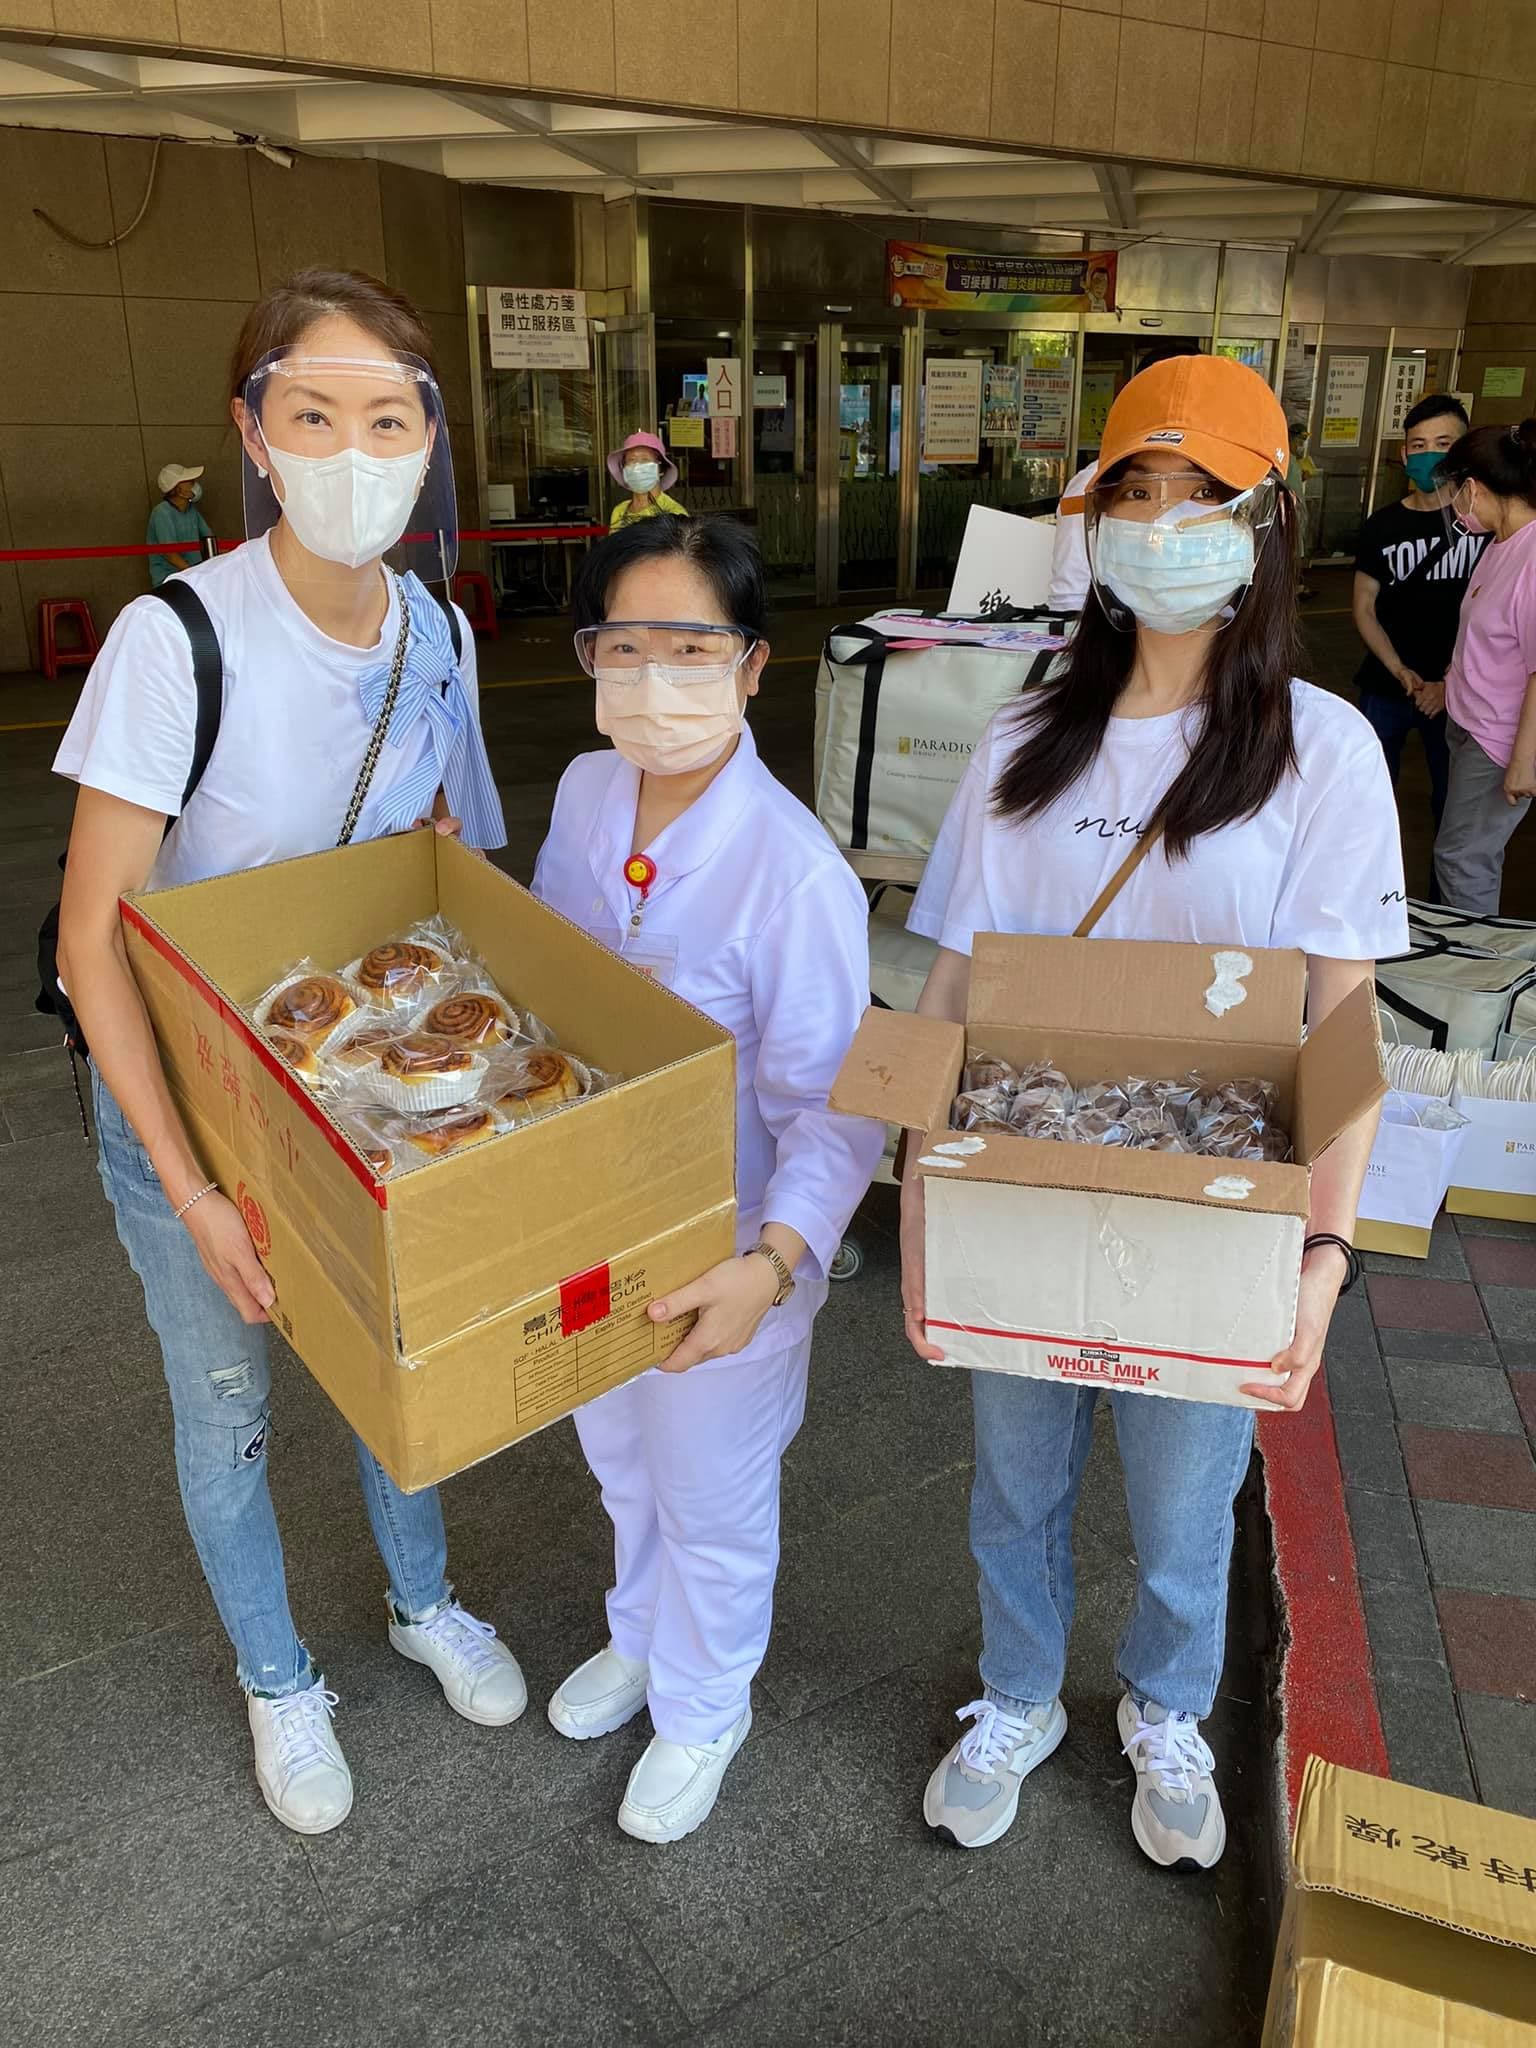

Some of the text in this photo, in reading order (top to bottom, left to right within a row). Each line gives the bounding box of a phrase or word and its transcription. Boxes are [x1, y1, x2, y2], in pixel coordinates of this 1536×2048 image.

[500, 292, 575, 311] 慢性處方箋
[501, 314, 576, 332] 開立服務區
[715, 364, 732, 409] 入口
[1382, 536, 1485, 585] TOMMY
[914, 738, 976, 753] PARADIS
[616, 1313, 632, 1324] Date
[533, 1350, 559, 1365] Product
[1048, 1355, 1110, 1375] WHOLE
[1115, 1364, 1160, 1381] MILK
